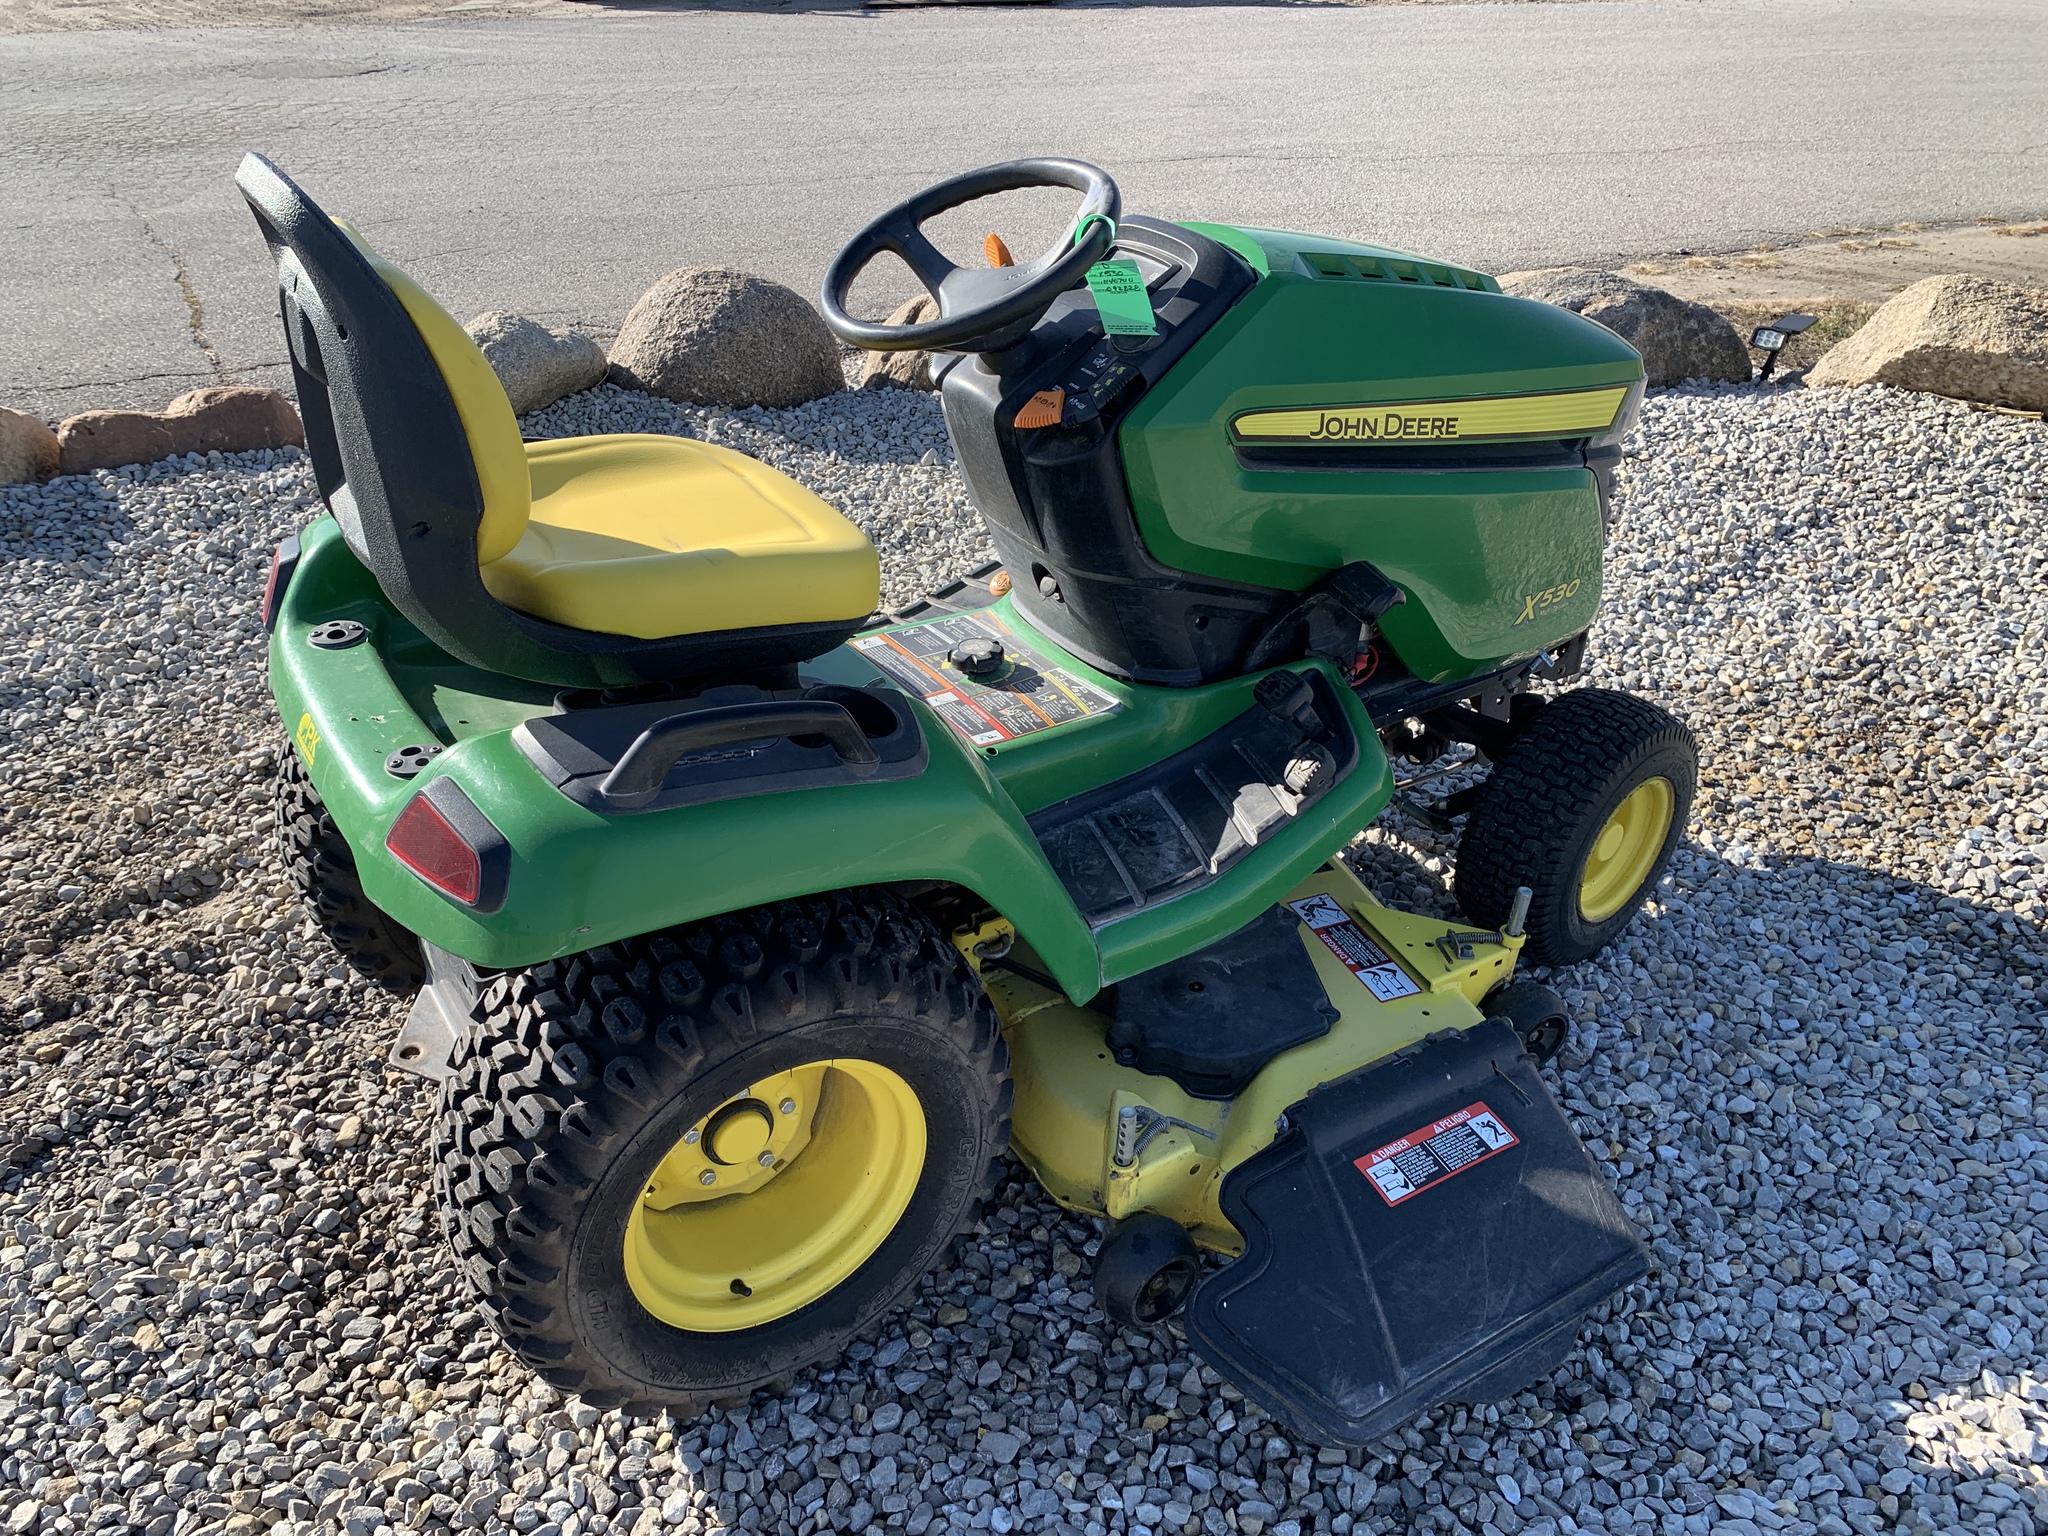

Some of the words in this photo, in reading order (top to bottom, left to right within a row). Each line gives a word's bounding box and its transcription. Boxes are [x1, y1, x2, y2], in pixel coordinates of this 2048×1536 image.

[1310, 413, 1378, 438] JOHN
[1384, 414, 1459, 437] DEERE
[1510, 577, 1581, 627] X530
[1320, 933, 1349, 959] DANGER
[1441, 1110, 1472, 1131] PELIGRO
[1379, 1139, 1411, 1160] DANGER
[870, 1136, 977, 1311] CARLISLE
